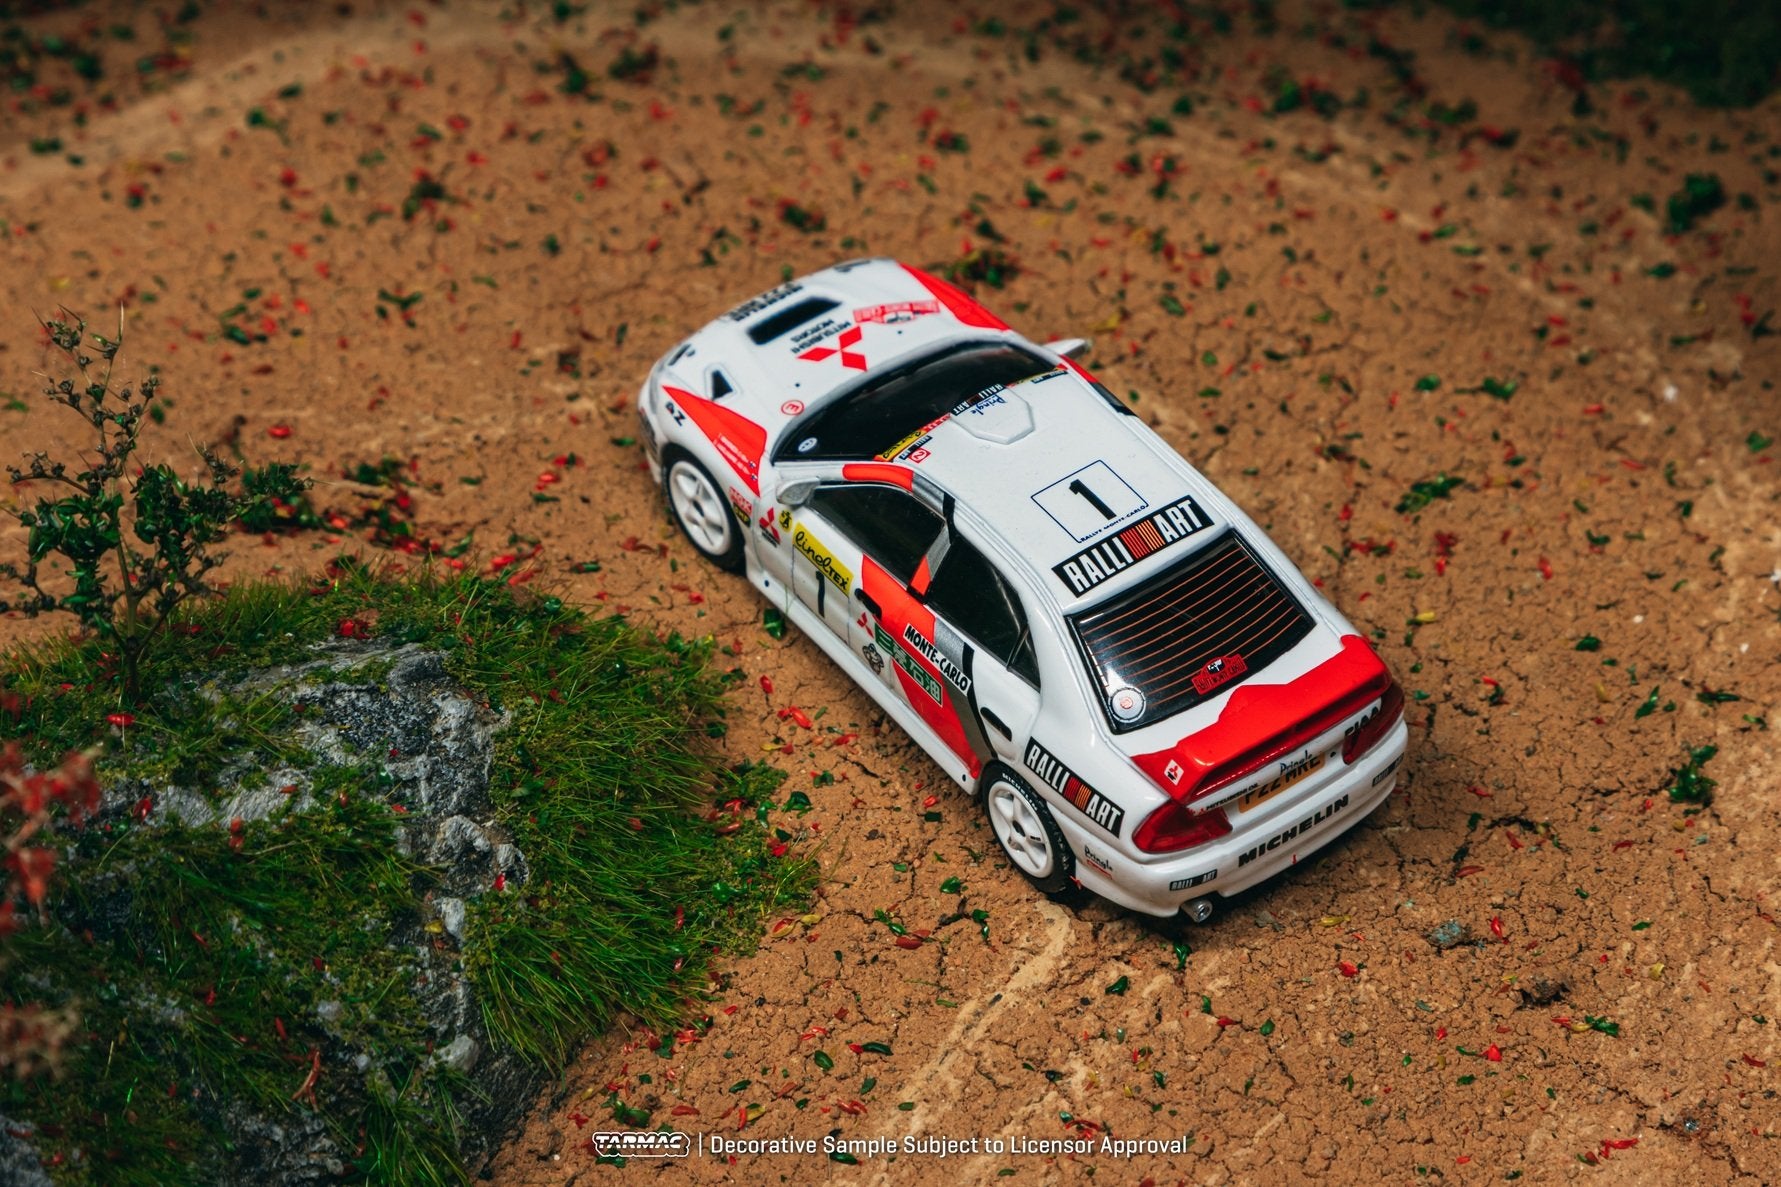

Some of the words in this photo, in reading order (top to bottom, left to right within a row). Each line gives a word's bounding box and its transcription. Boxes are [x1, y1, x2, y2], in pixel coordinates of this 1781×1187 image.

[971, 395, 1008, 416] Pringle
[1069, 479, 1117, 521] 1
[1062, 537, 1134, 593] RALLI
[1153, 500, 1203, 543] ART
[815, 571, 826, 619] 1
[904, 625, 968, 692] MONTE-CARLO
[1026, 744, 1070, 794] RALLI
[1085, 793, 1122, 831] ART
[1238, 794, 1349, 868] MICHELIN
